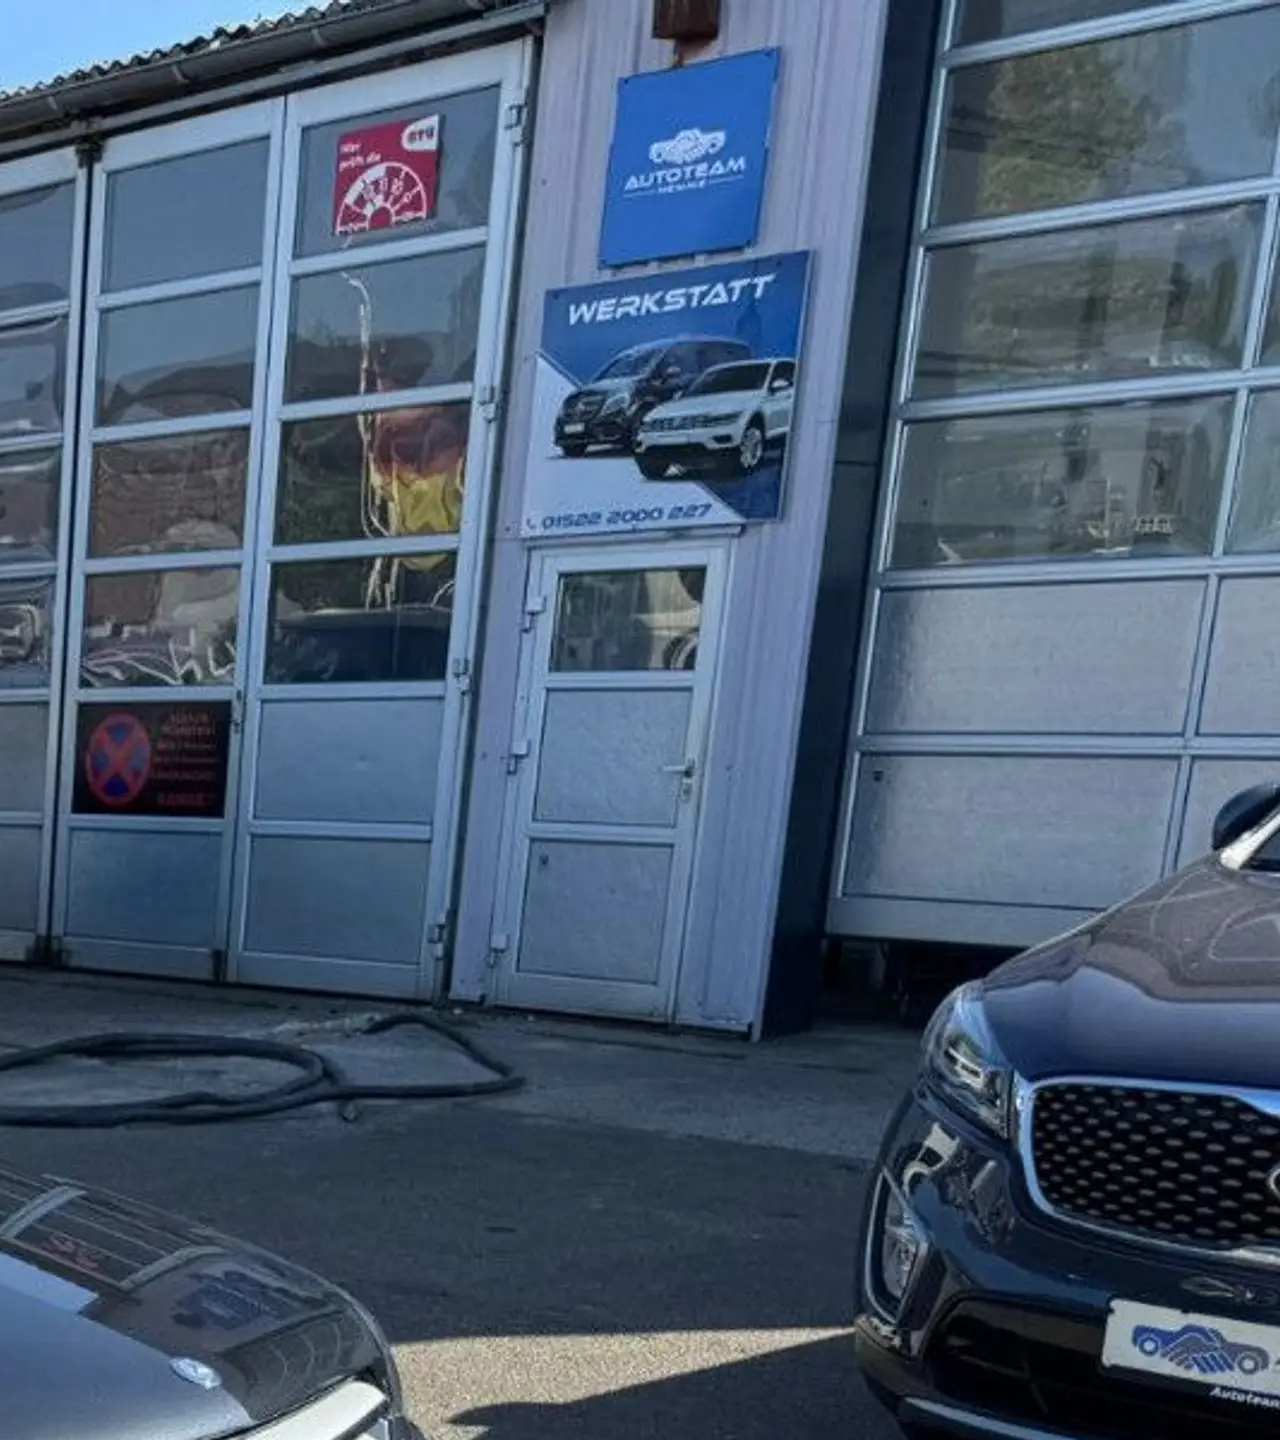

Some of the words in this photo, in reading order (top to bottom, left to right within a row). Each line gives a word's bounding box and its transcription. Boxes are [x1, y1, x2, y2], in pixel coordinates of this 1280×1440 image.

[624, 156, 745, 191] AUTOTEAM
[568, 274, 776, 326] WERKSTATT
[542, 513, 601, 530] 01522
[607, 507, 663, 524] 2000
[668, 504, 712, 520] 227
